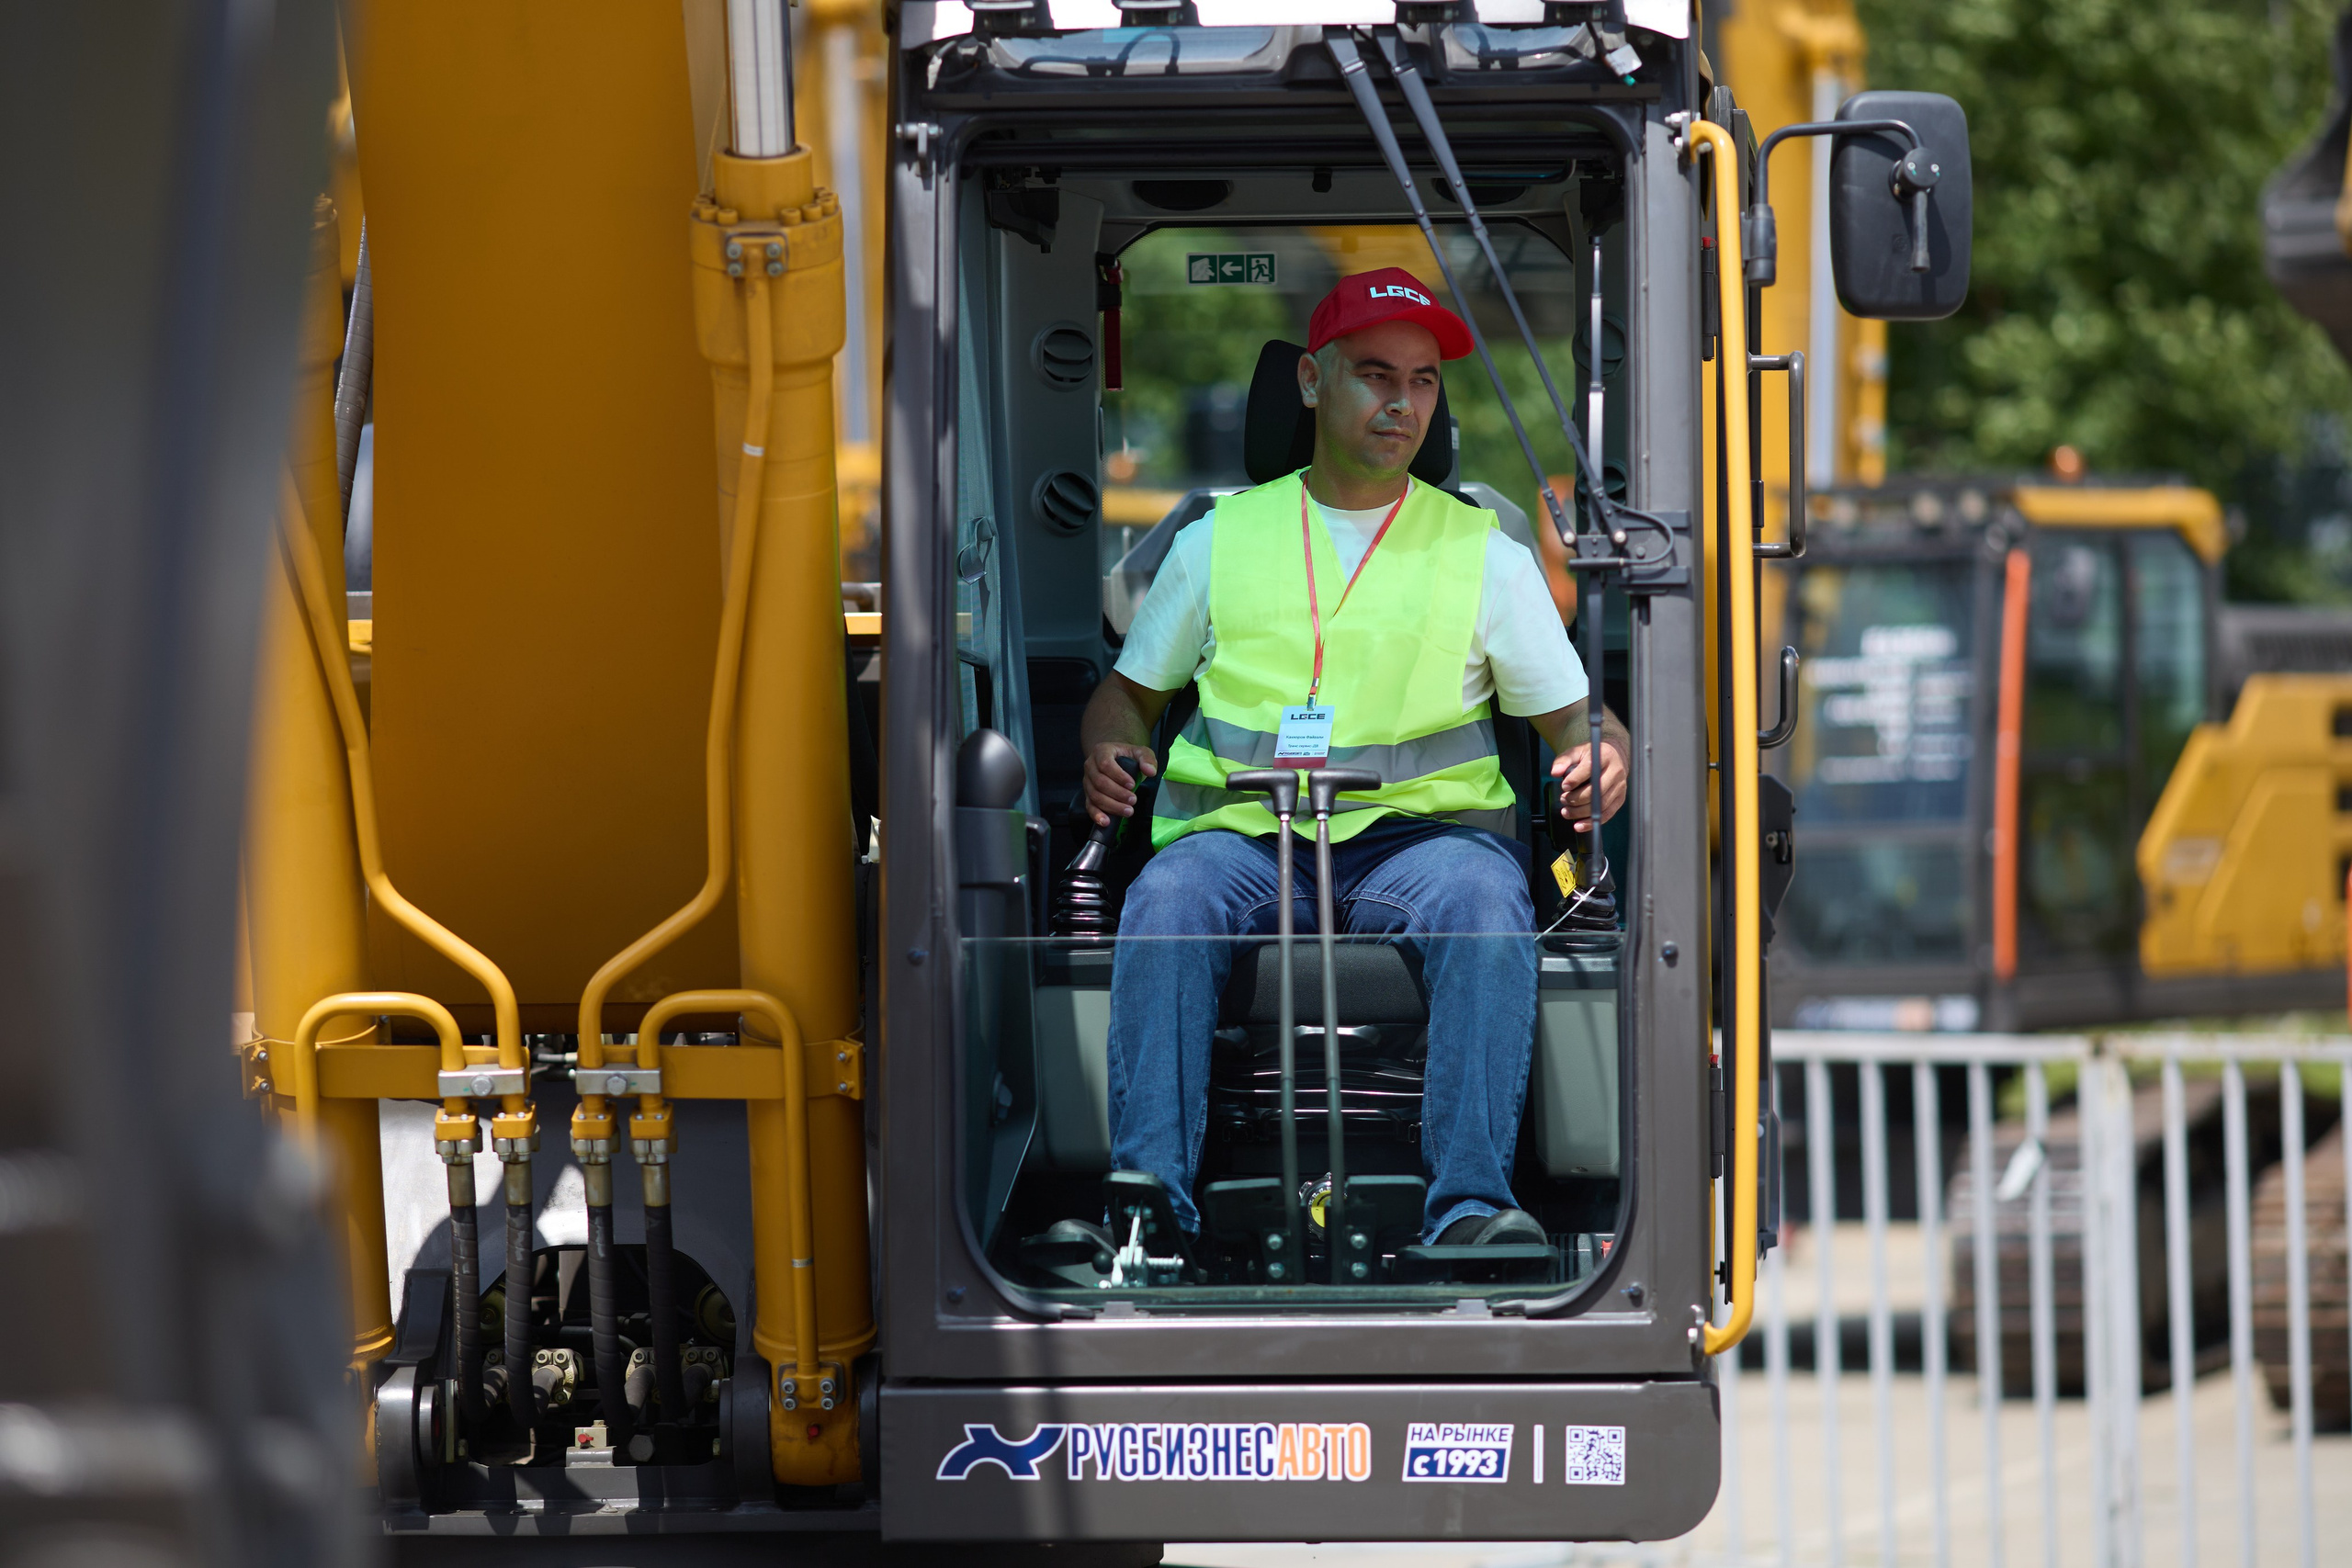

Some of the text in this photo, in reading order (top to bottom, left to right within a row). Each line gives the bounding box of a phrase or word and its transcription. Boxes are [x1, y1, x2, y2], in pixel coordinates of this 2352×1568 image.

[1410, 1427, 1510, 1442] НА РЫНКЕ
[1069, 1424, 1370, 1479] РУСБИЗНЕСАВТО
[1432, 1449, 1499, 1476] 1993
